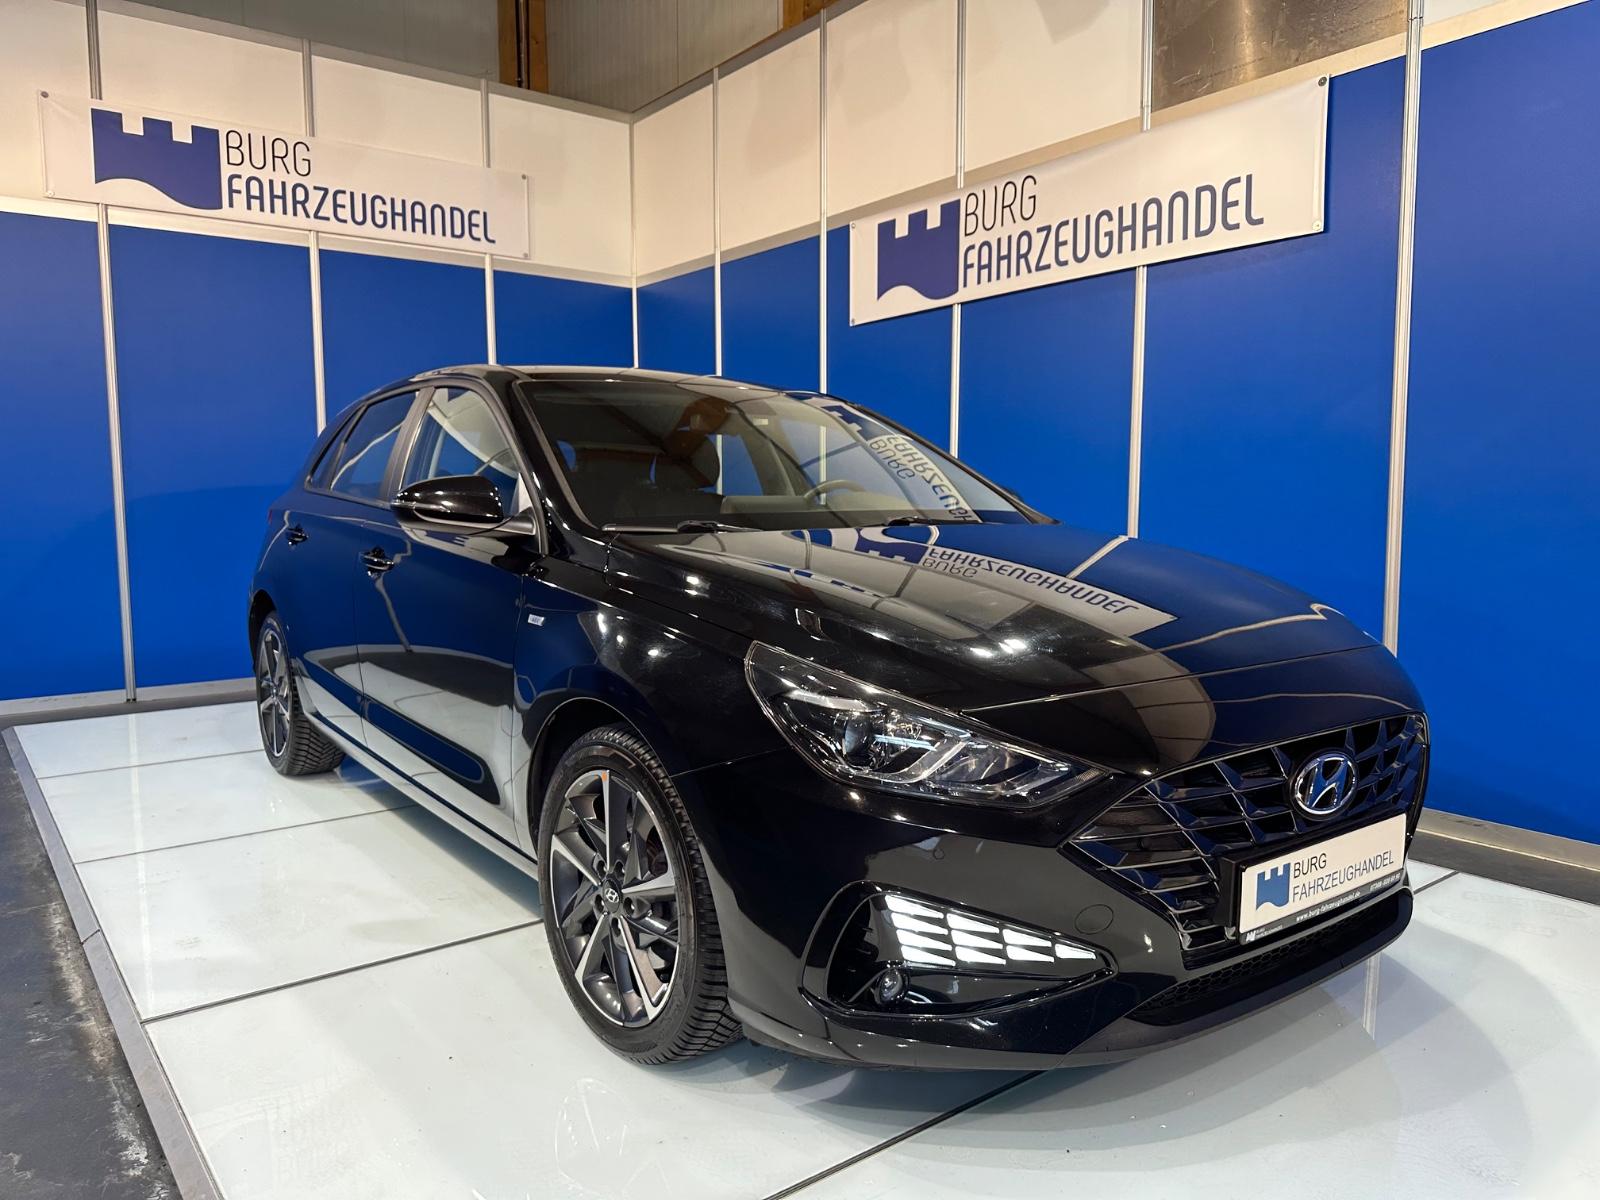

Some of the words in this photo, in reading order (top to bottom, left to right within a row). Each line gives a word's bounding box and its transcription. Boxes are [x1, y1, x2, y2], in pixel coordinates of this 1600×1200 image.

[225, 129, 312, 177] BURG
[227, 173, 496, 244] FAHRZEUGHANDEL
[963, 173, 1264, 288] FAHRZEUGHANDEL
[964, 175, 1037, 237] BURG
[1292, 850, 1394, 902] FAHRZEUGHANDEL
[1293, 853, 1327, 878] BURG
